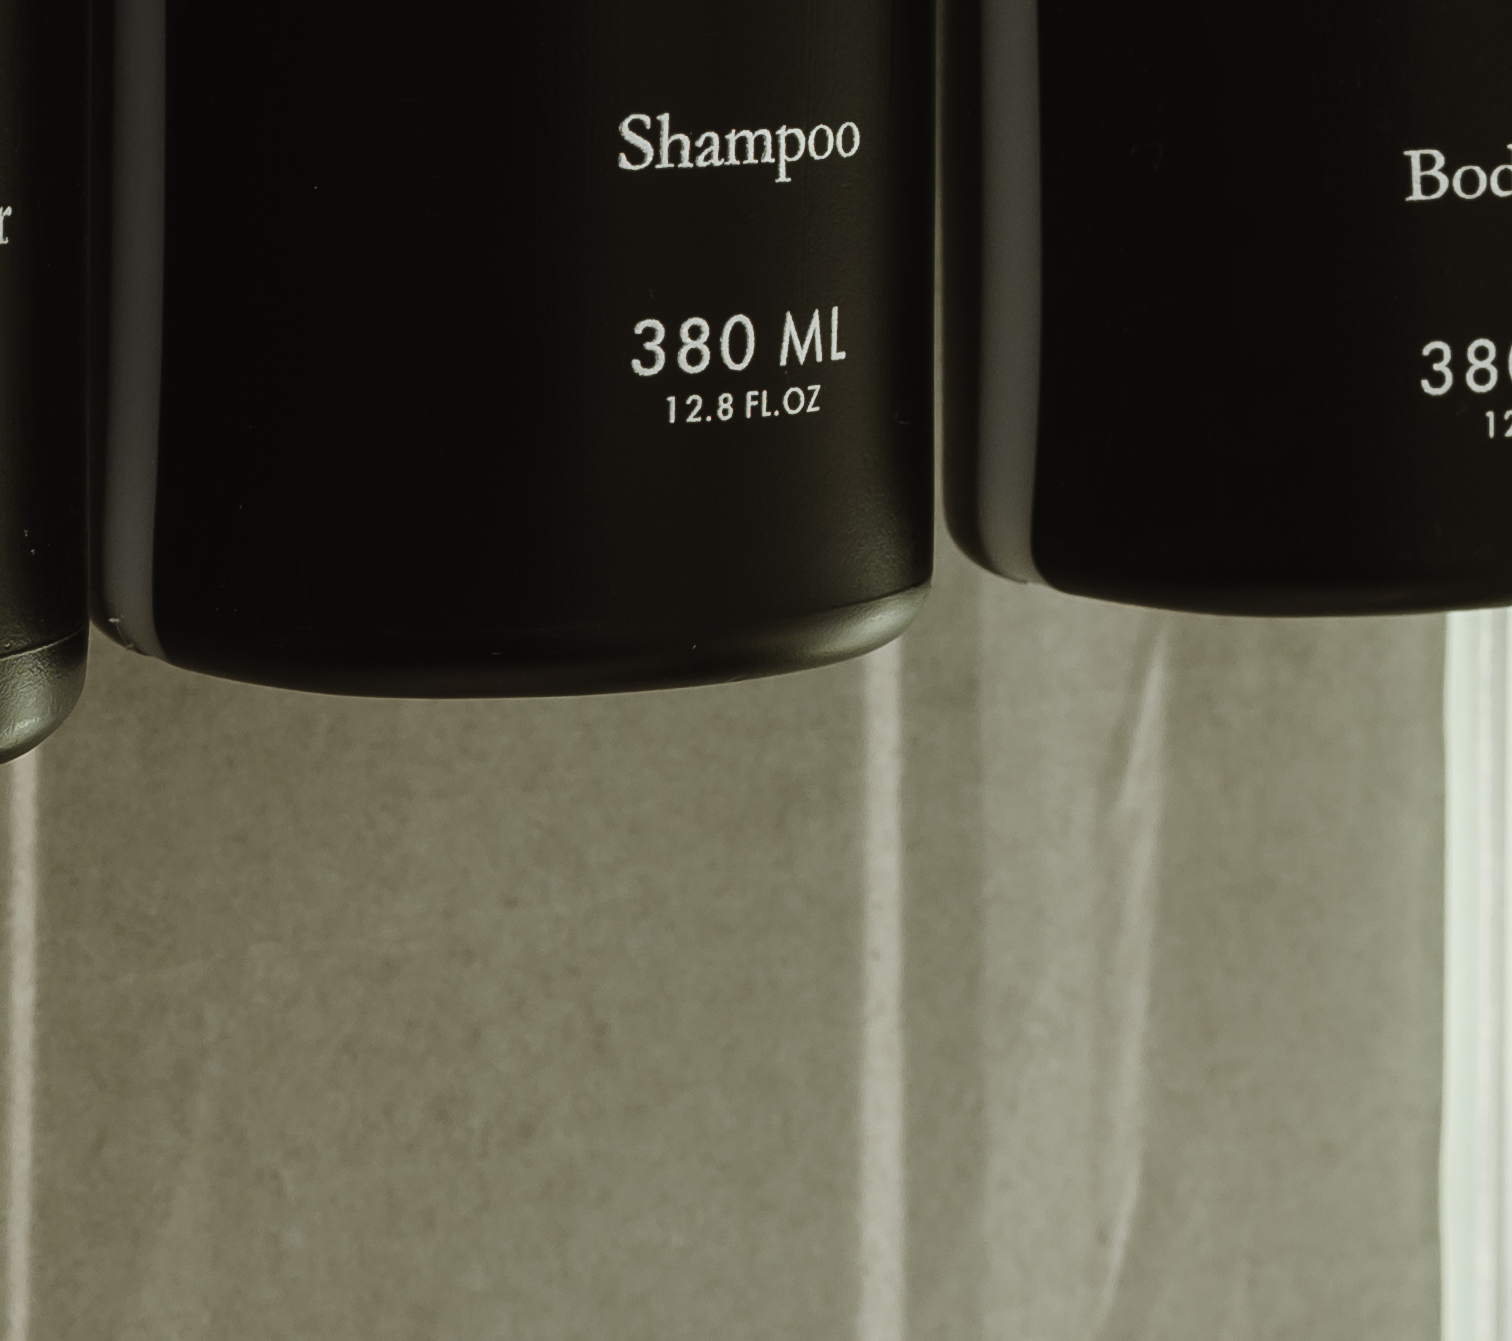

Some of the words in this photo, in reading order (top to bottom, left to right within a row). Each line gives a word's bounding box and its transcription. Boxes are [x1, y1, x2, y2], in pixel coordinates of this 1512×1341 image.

[619, 113, 860, 183] Shampoo
[631, 314, 755, 376] 380
[780, 306, 846, 366] ML
[667, 393, 733, 423] 12.8
[746, 385, 821, 418] FL.OZ
